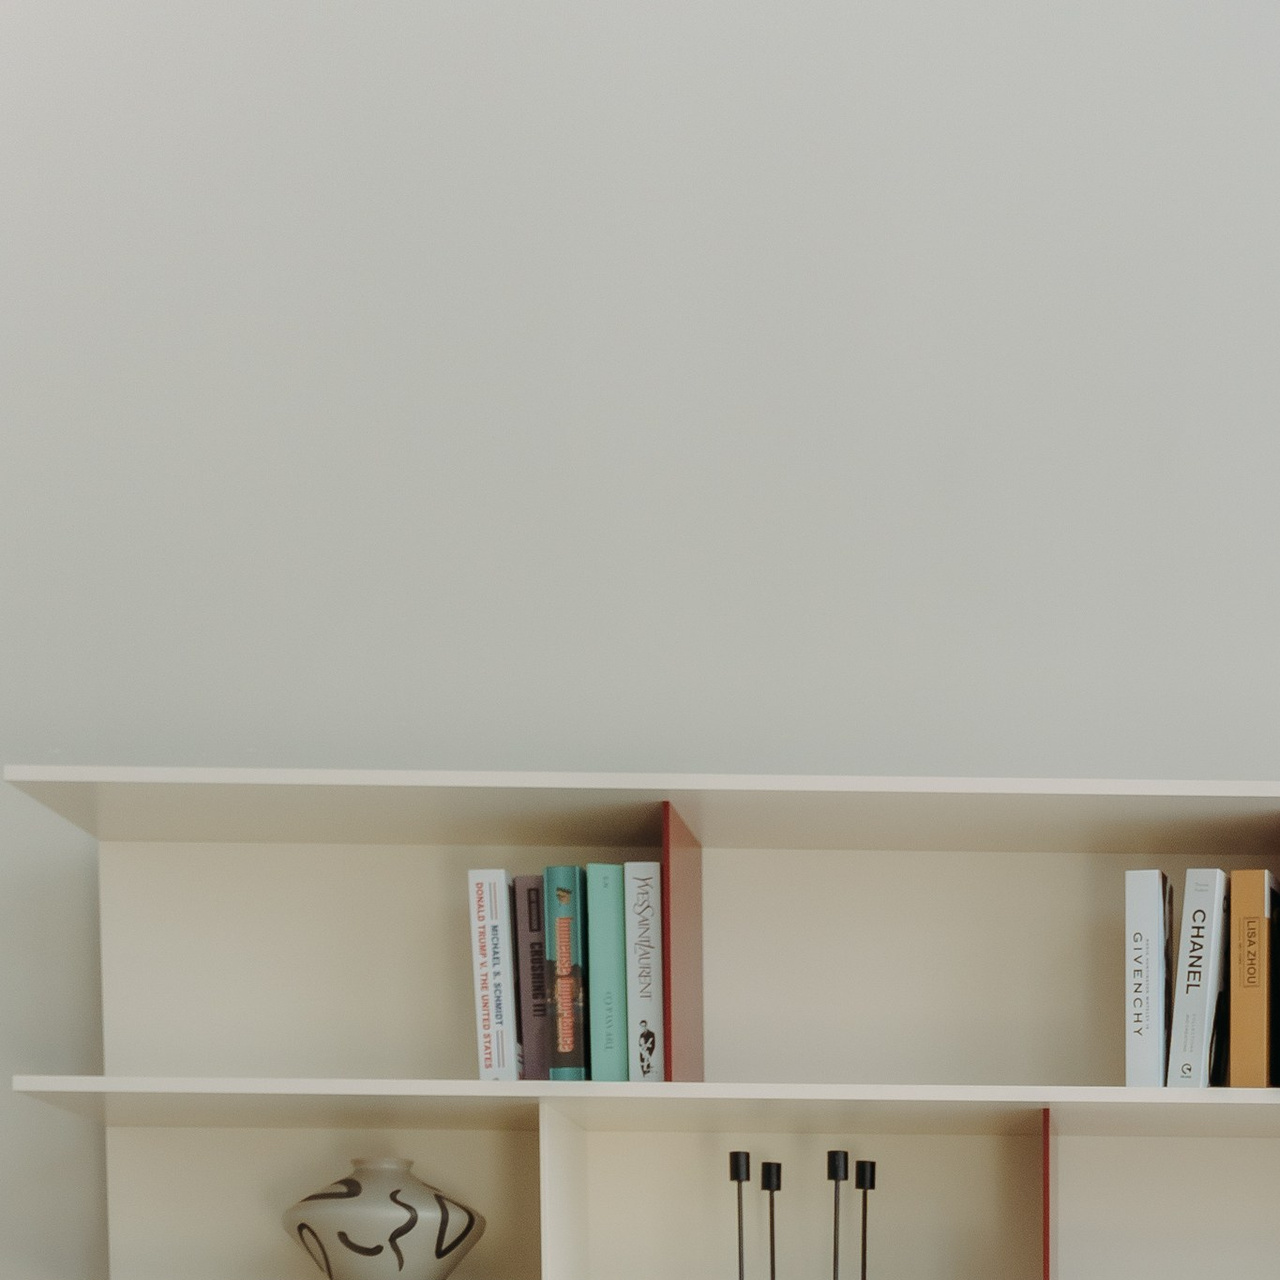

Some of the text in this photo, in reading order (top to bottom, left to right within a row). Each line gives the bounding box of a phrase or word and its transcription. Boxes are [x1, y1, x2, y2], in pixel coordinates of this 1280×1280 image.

[475, 882, 485, 921] DONALD
[478, 925, 487, 958] TRUMP
[490, 924, 500, 967] MICHAEL
[1185, 909, 1206, 995] CHANEL
[1247, 920, 1257, 984] LISA ZHOU
[480, 972, 489, 991] THE
[530, 941, 546, 1000] CRUSHING
[1133, 932, 1143, 1036] GIVENCHY
[481, 994, 491, 1030] UNITED
[493, 982, 504, 1026] SCHMIDT
[483, 1033, 493, 1069] STATES
